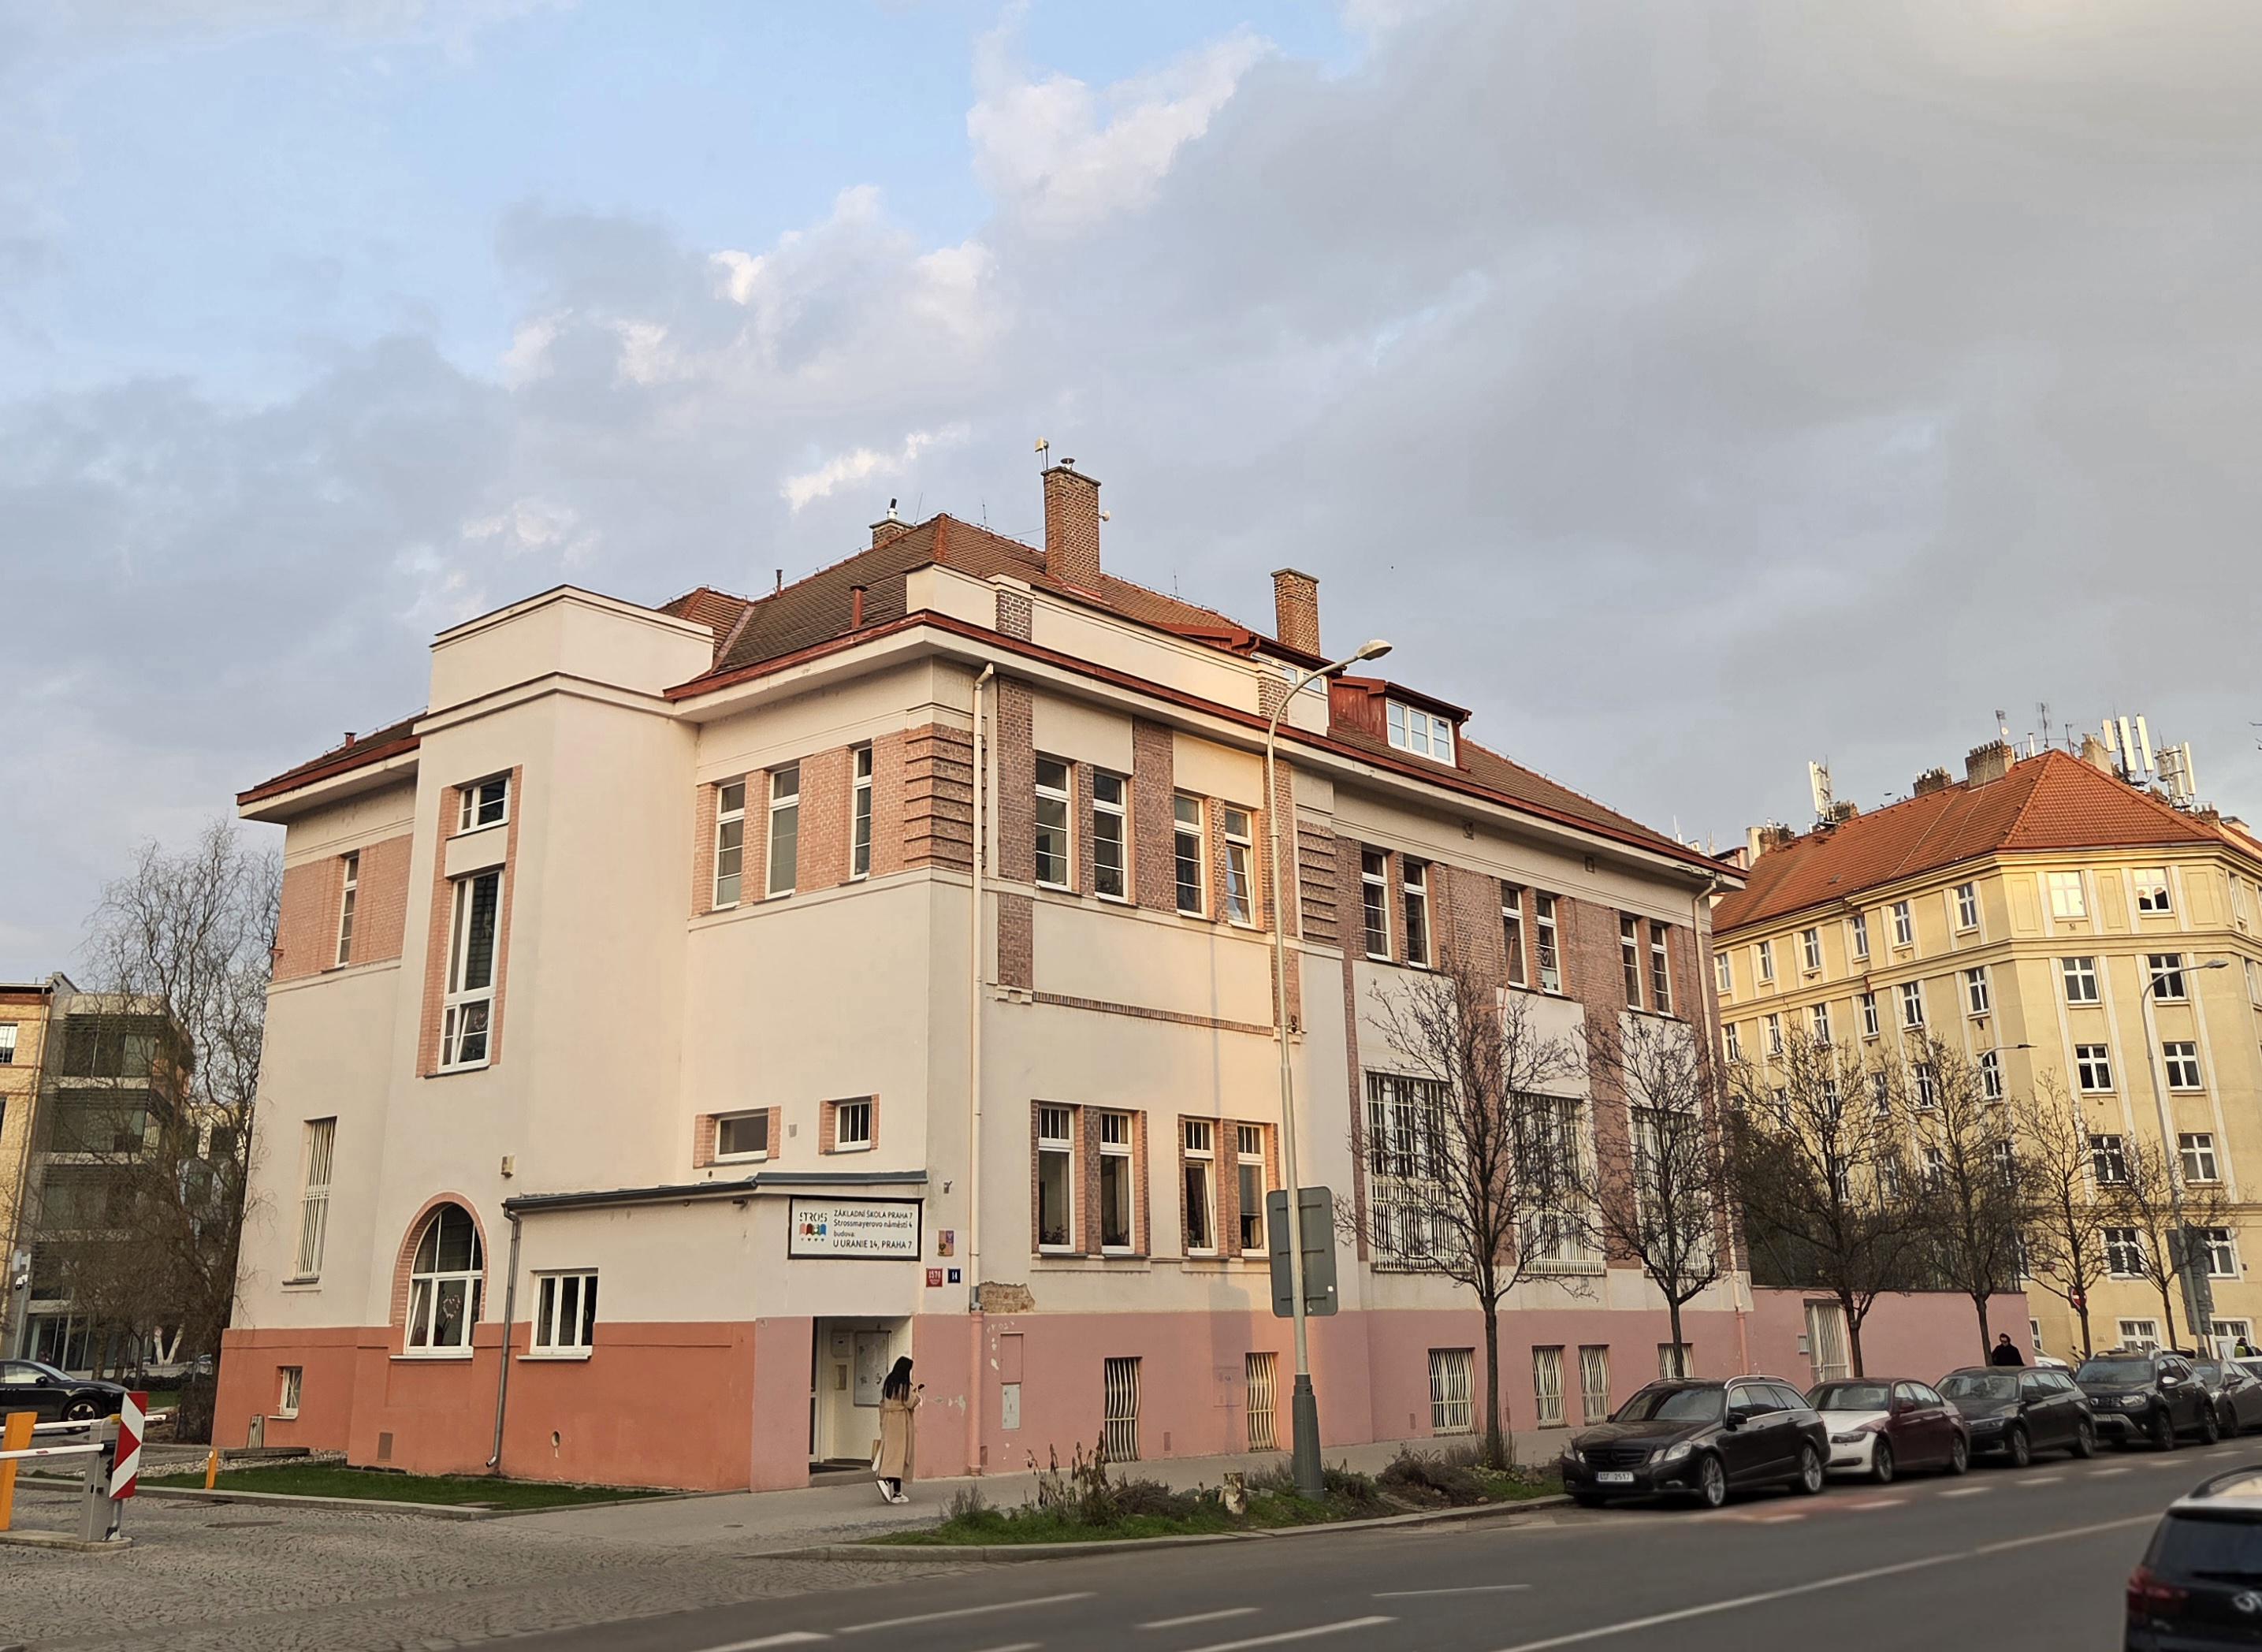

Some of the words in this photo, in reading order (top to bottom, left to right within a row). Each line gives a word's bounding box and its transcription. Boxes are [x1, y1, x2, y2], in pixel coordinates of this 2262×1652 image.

[834, 1208, 865, 1218] ZÁKLADNÍ
[866, 1209, 887, 1219] ŠKOLA
[887, 1211, 908, 1219] PRAHA
[833, 1219, 883, 1229] Strossmayerovo
[884, 1219, 908, 1229] náměstí
[833, 1239, 839, 1248] U
[840, 1239, 868, 1248] URANIE
[869, 1240, 880, 1251] 14,
[881, 1240, 906, 1249] PRAHA
[908, 1241, 913, 1249] 7
[951, 1271, 958, 1280] 14
